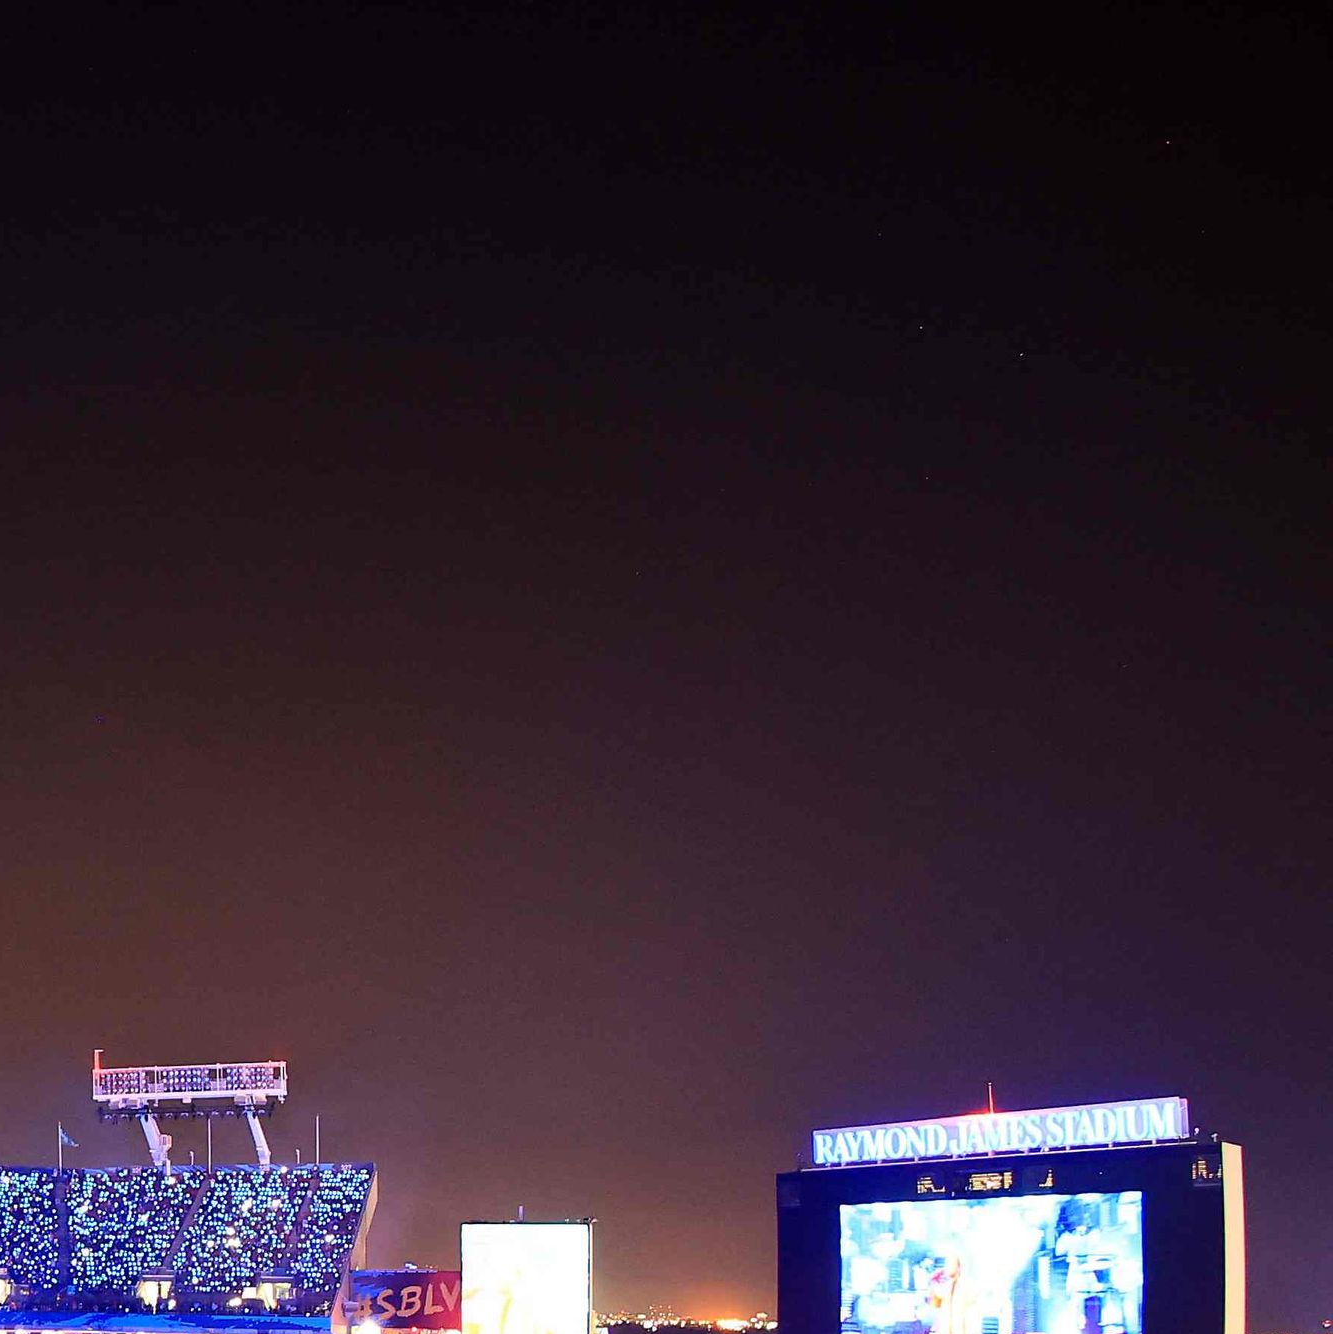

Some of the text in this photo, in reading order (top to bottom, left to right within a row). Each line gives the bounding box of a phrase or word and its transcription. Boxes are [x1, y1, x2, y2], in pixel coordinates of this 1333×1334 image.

[815, 1102, 1180, 1164] RAYMOND JAMES STADIUM
